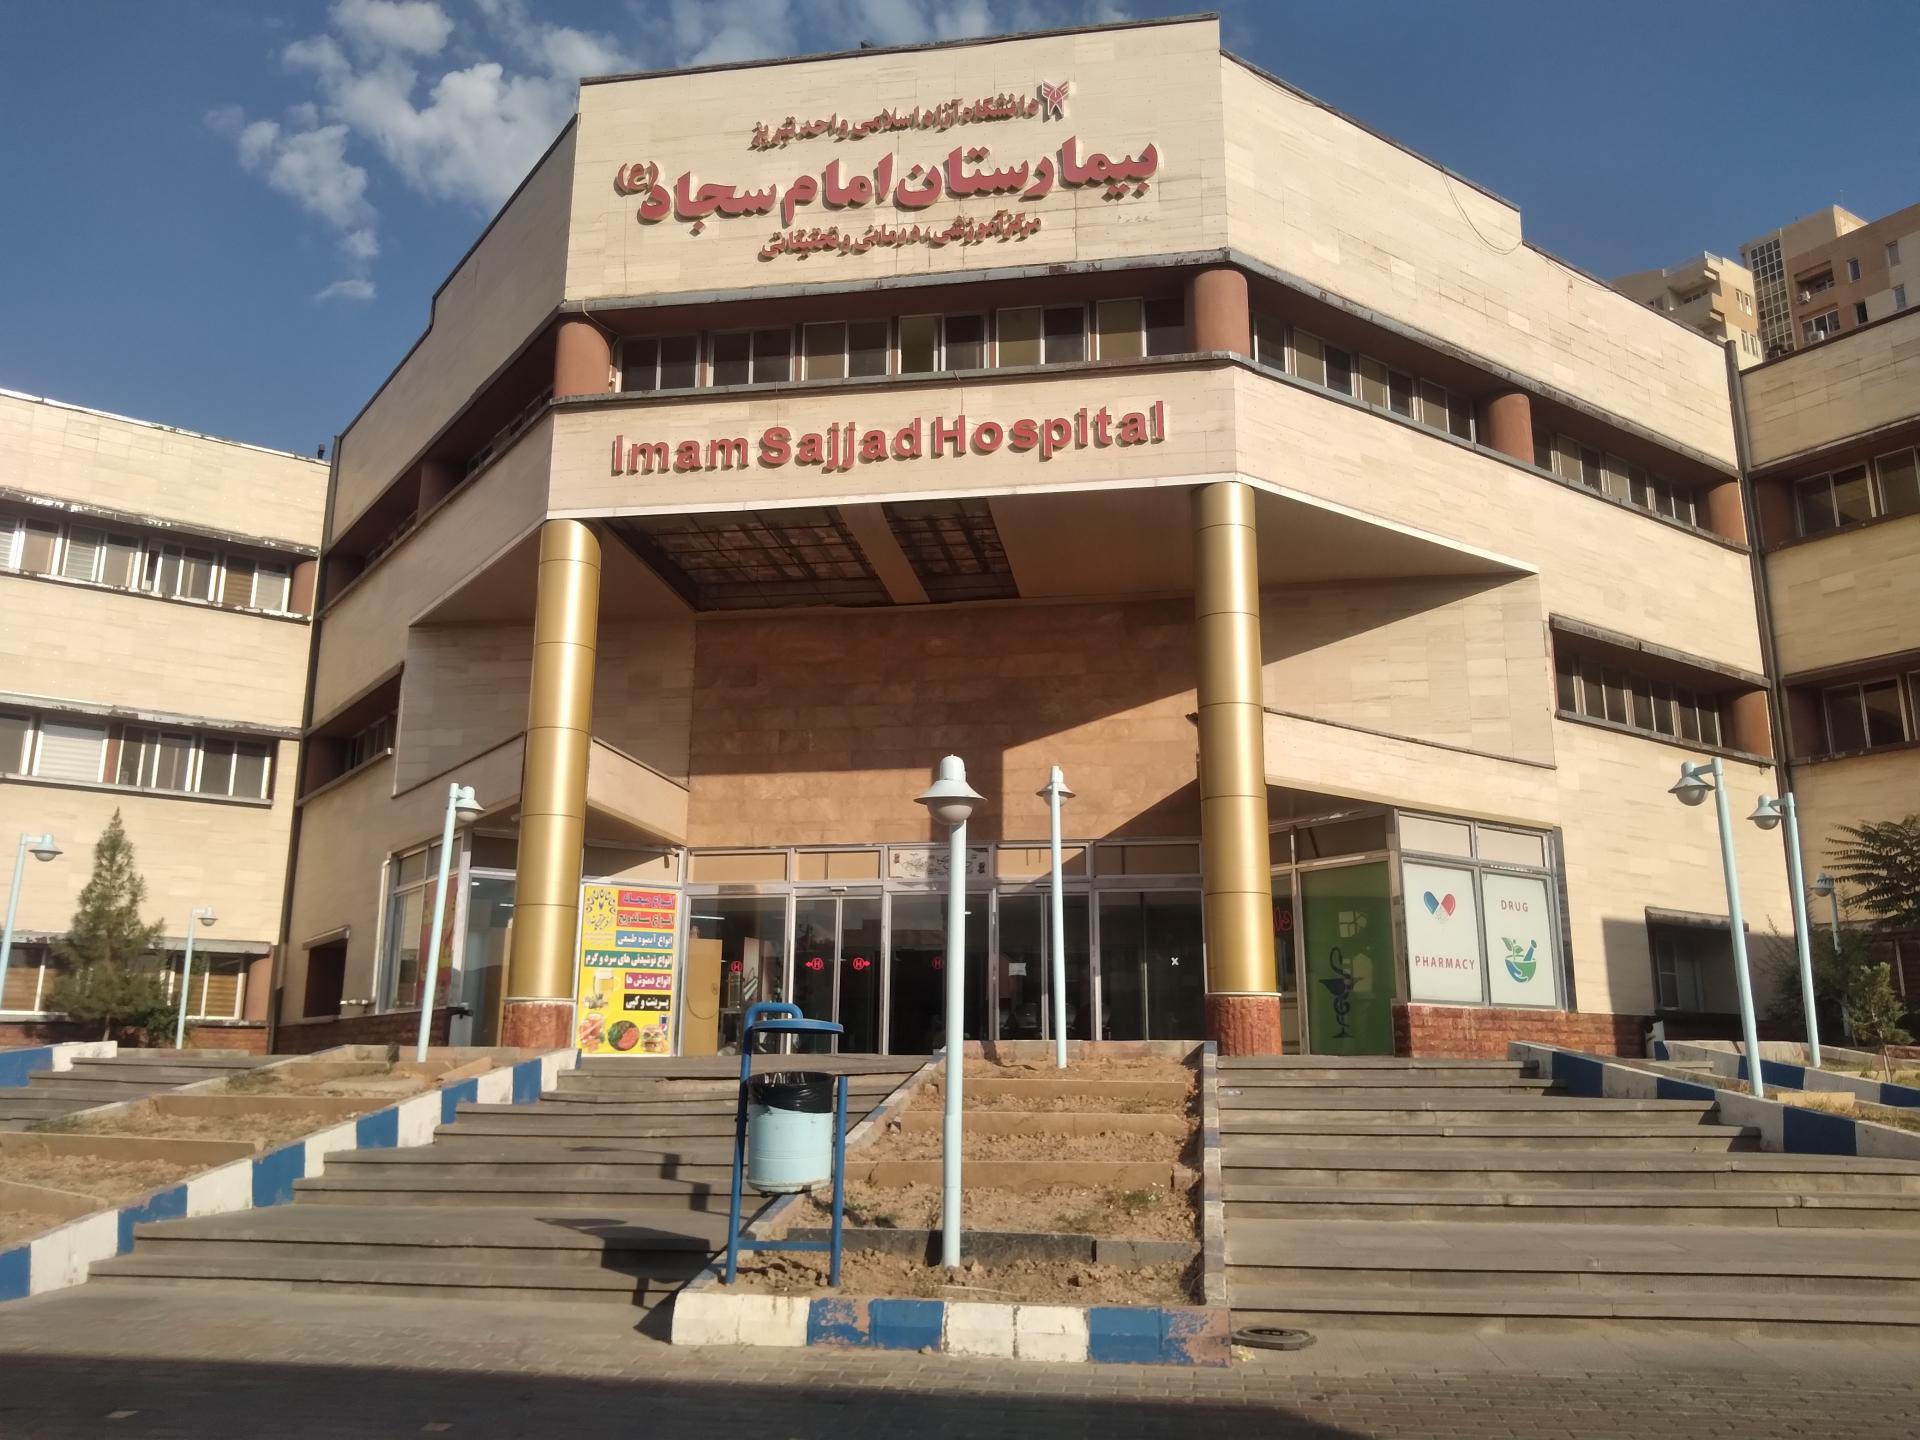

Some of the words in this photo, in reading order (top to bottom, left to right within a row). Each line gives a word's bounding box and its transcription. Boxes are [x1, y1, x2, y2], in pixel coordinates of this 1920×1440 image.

[852, 105, 920, 138] اسلامی
[923, 98, 963, 131] آزاد
[962, 91, 1040, 124] دانشگاه
[750, 116, 797, 149] تبریز
[799, 112, 849, 141] واحد
[896, 136, 1159, 208] بیمارستان
[639, 171, 777, 234] سجاد
[783, 151, 894, 226] امام
[853, 223, 921, 252] درمانی
[1001, 210, 1042, 241] مرکز
[760, 225, 840, 261] تحقیقاتی
[613, 434, 750, 474] Imam
[759, 416, 924, 473] Sajjad
[933, 400, 1166, 460] Hospital
[1500, 899, 1529, 913] DRUG
[616, 932, 637, 945] طبیعی
[657, 935, 673, 948] انواع
[585, 952, 599, 965] گرم
[603, 953, 617, 965] سرد
[617, 953, 631, 966] های
[656, 955, 673, 968] انواع
[1414, 955, 1475, 970] PHARMACY
[655, 976, 671, 988] انواع
[625, 995, 641, 1009] کپی
